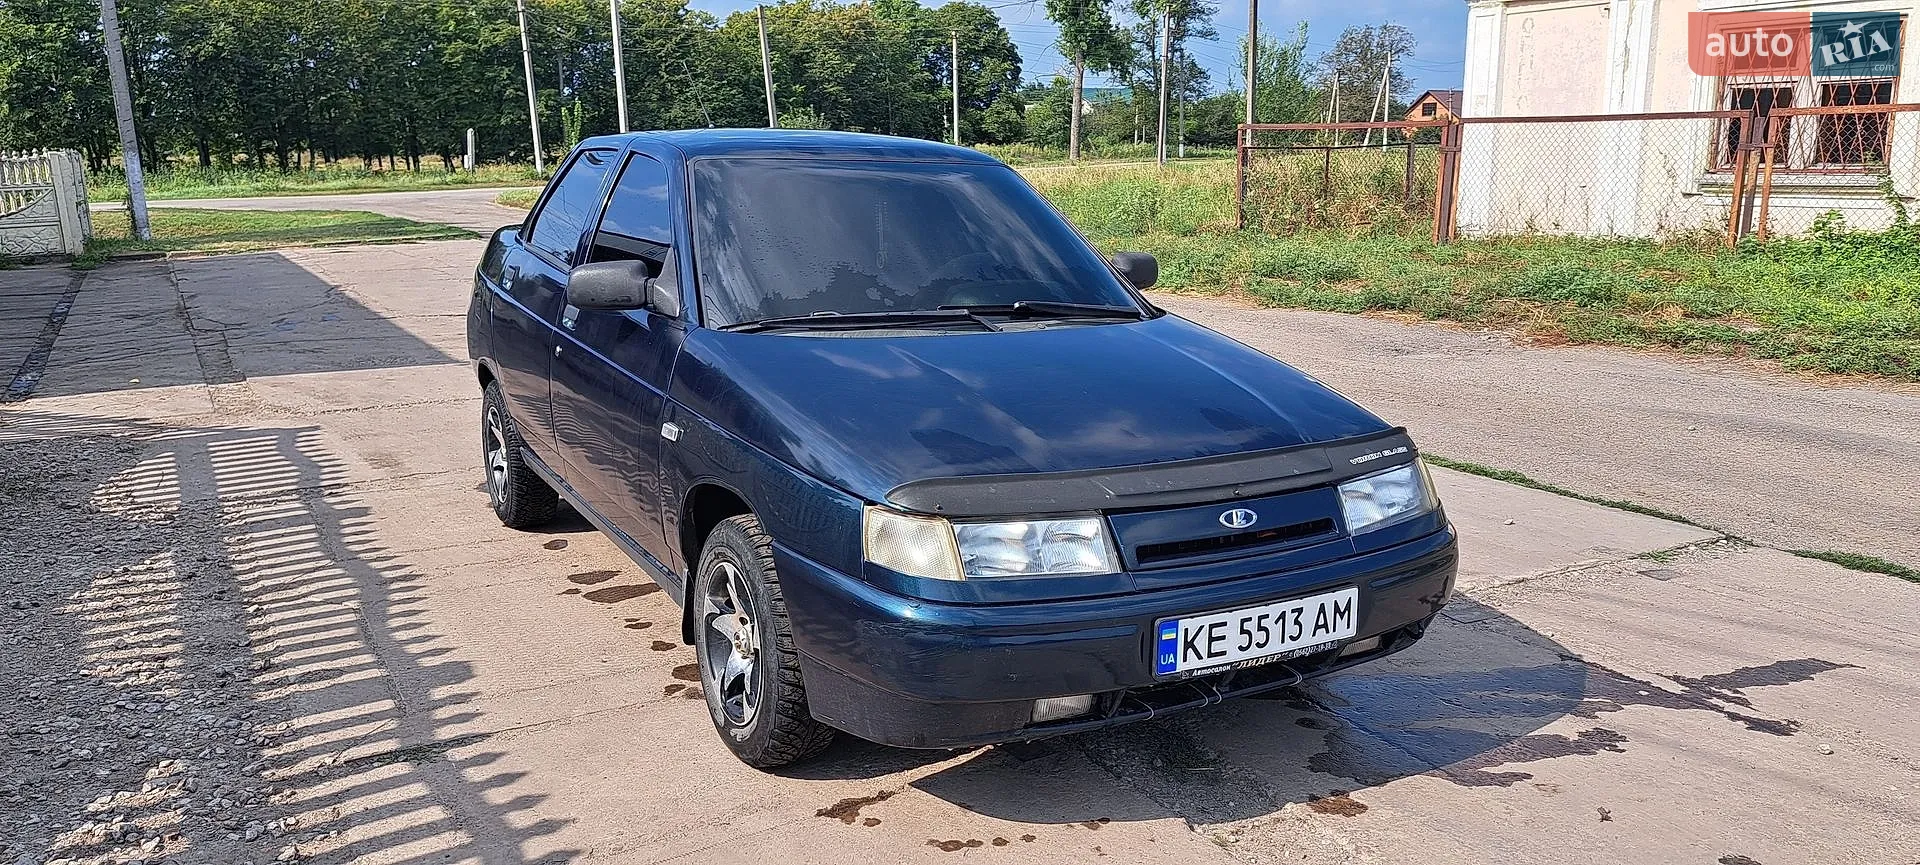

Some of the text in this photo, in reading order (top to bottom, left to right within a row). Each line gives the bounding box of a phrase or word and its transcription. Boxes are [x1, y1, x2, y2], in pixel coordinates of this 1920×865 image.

[1182, 596, 1352, 663] KE 5513 AM
[1160, 653, 1176, 665] UA
[1192, 664, 1231, 677] Автосалон
